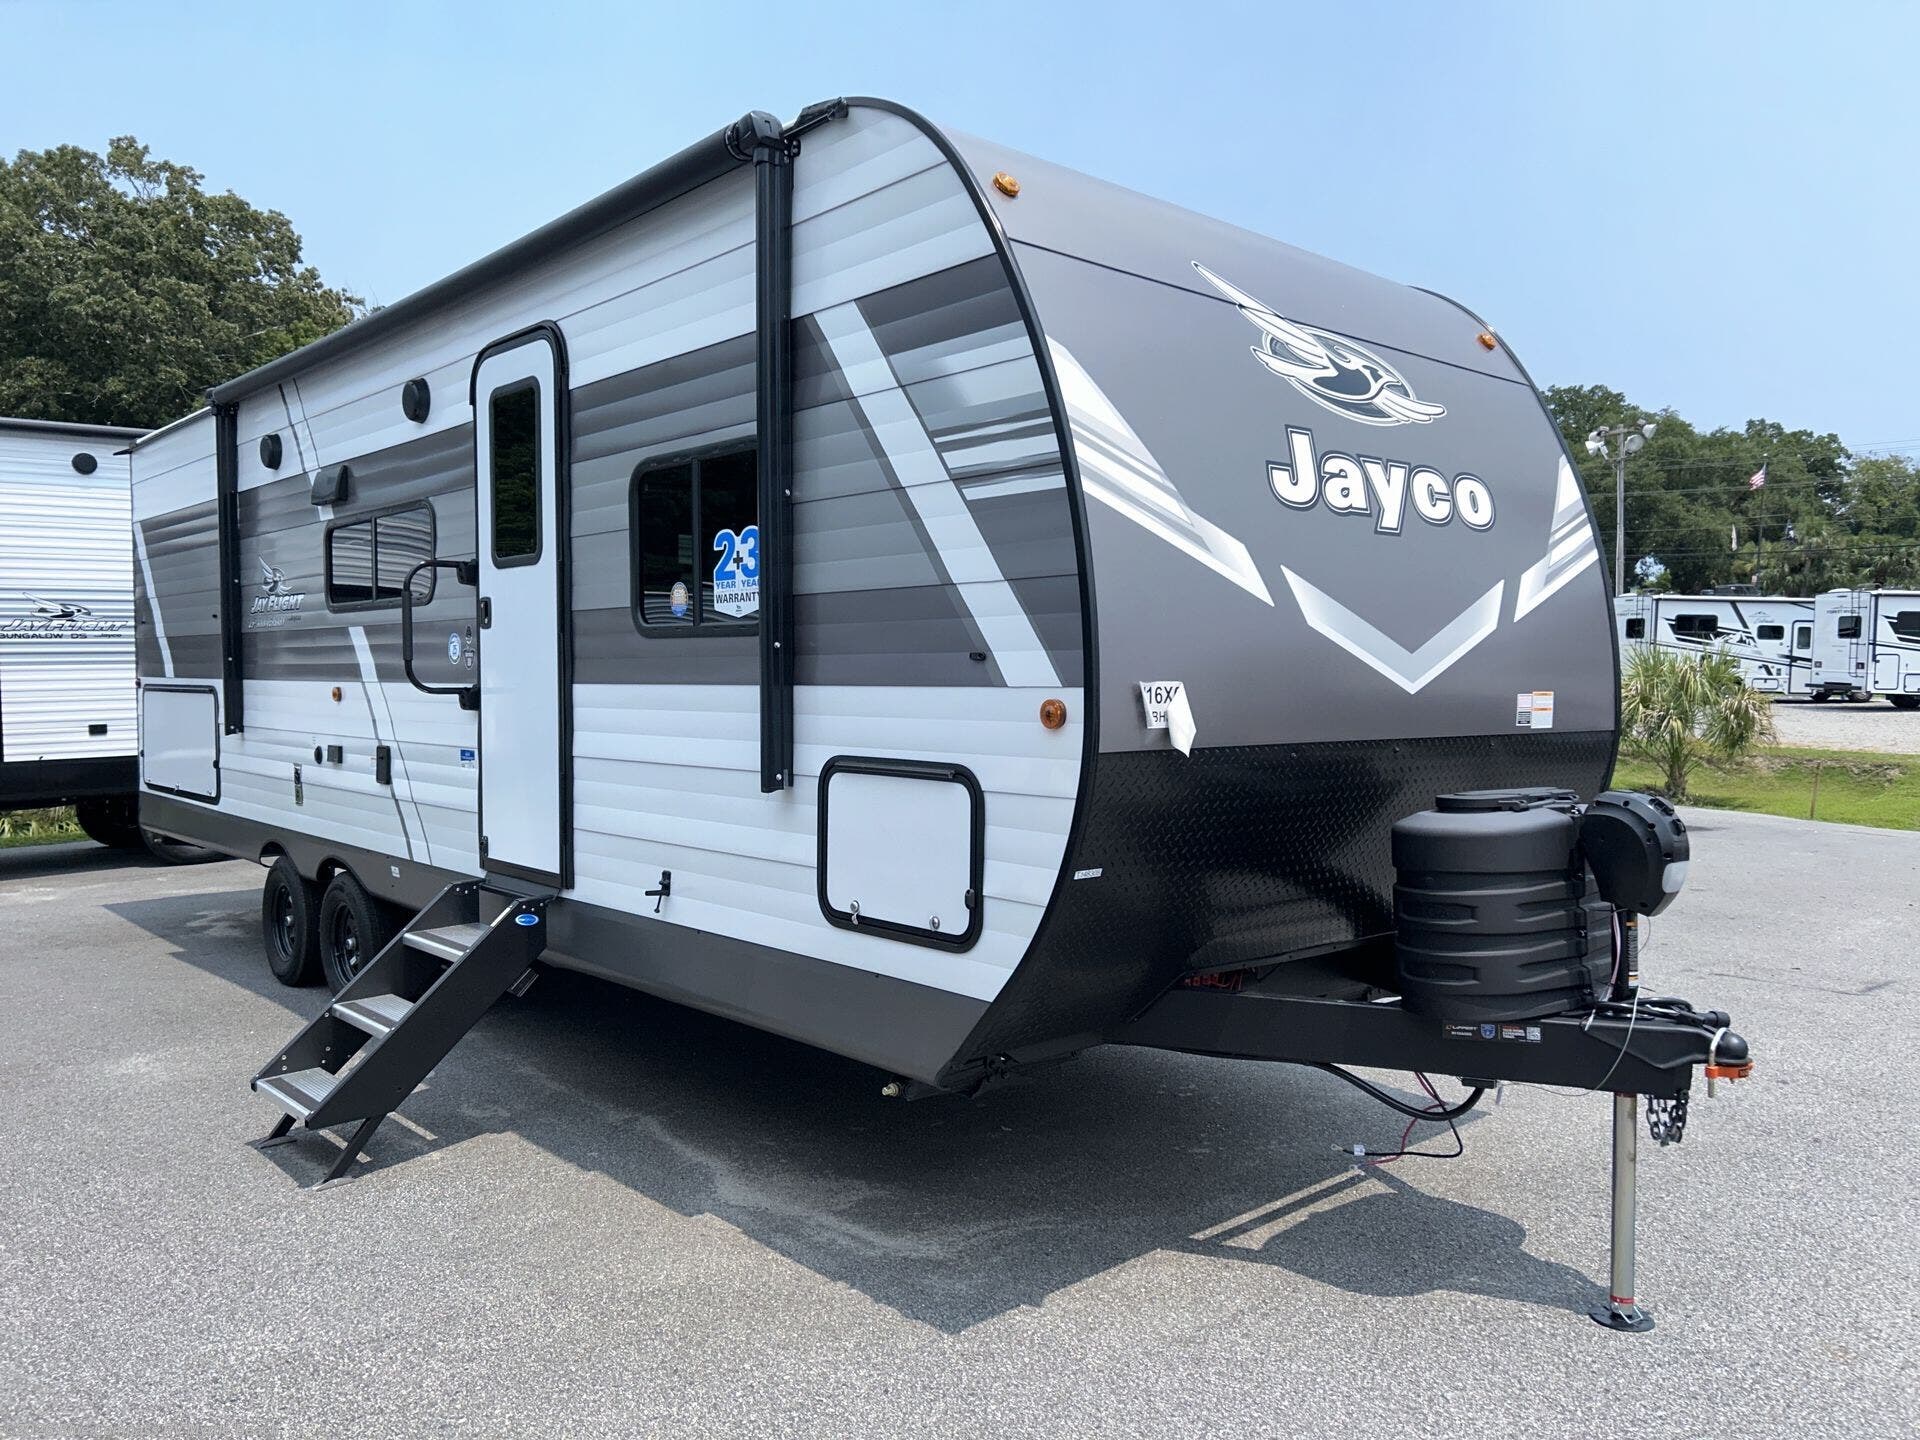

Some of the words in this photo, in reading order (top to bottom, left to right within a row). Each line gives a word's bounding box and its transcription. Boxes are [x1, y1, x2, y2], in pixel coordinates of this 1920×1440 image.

[1266, 424, 1496, 537] Jayco
[716, 581, 736, 589] YEAR
[266, 593, 305, 612] FLIGHT
[2, 619, 50, 631] JAY
[46, 620, 128, 631] FLIGHT
